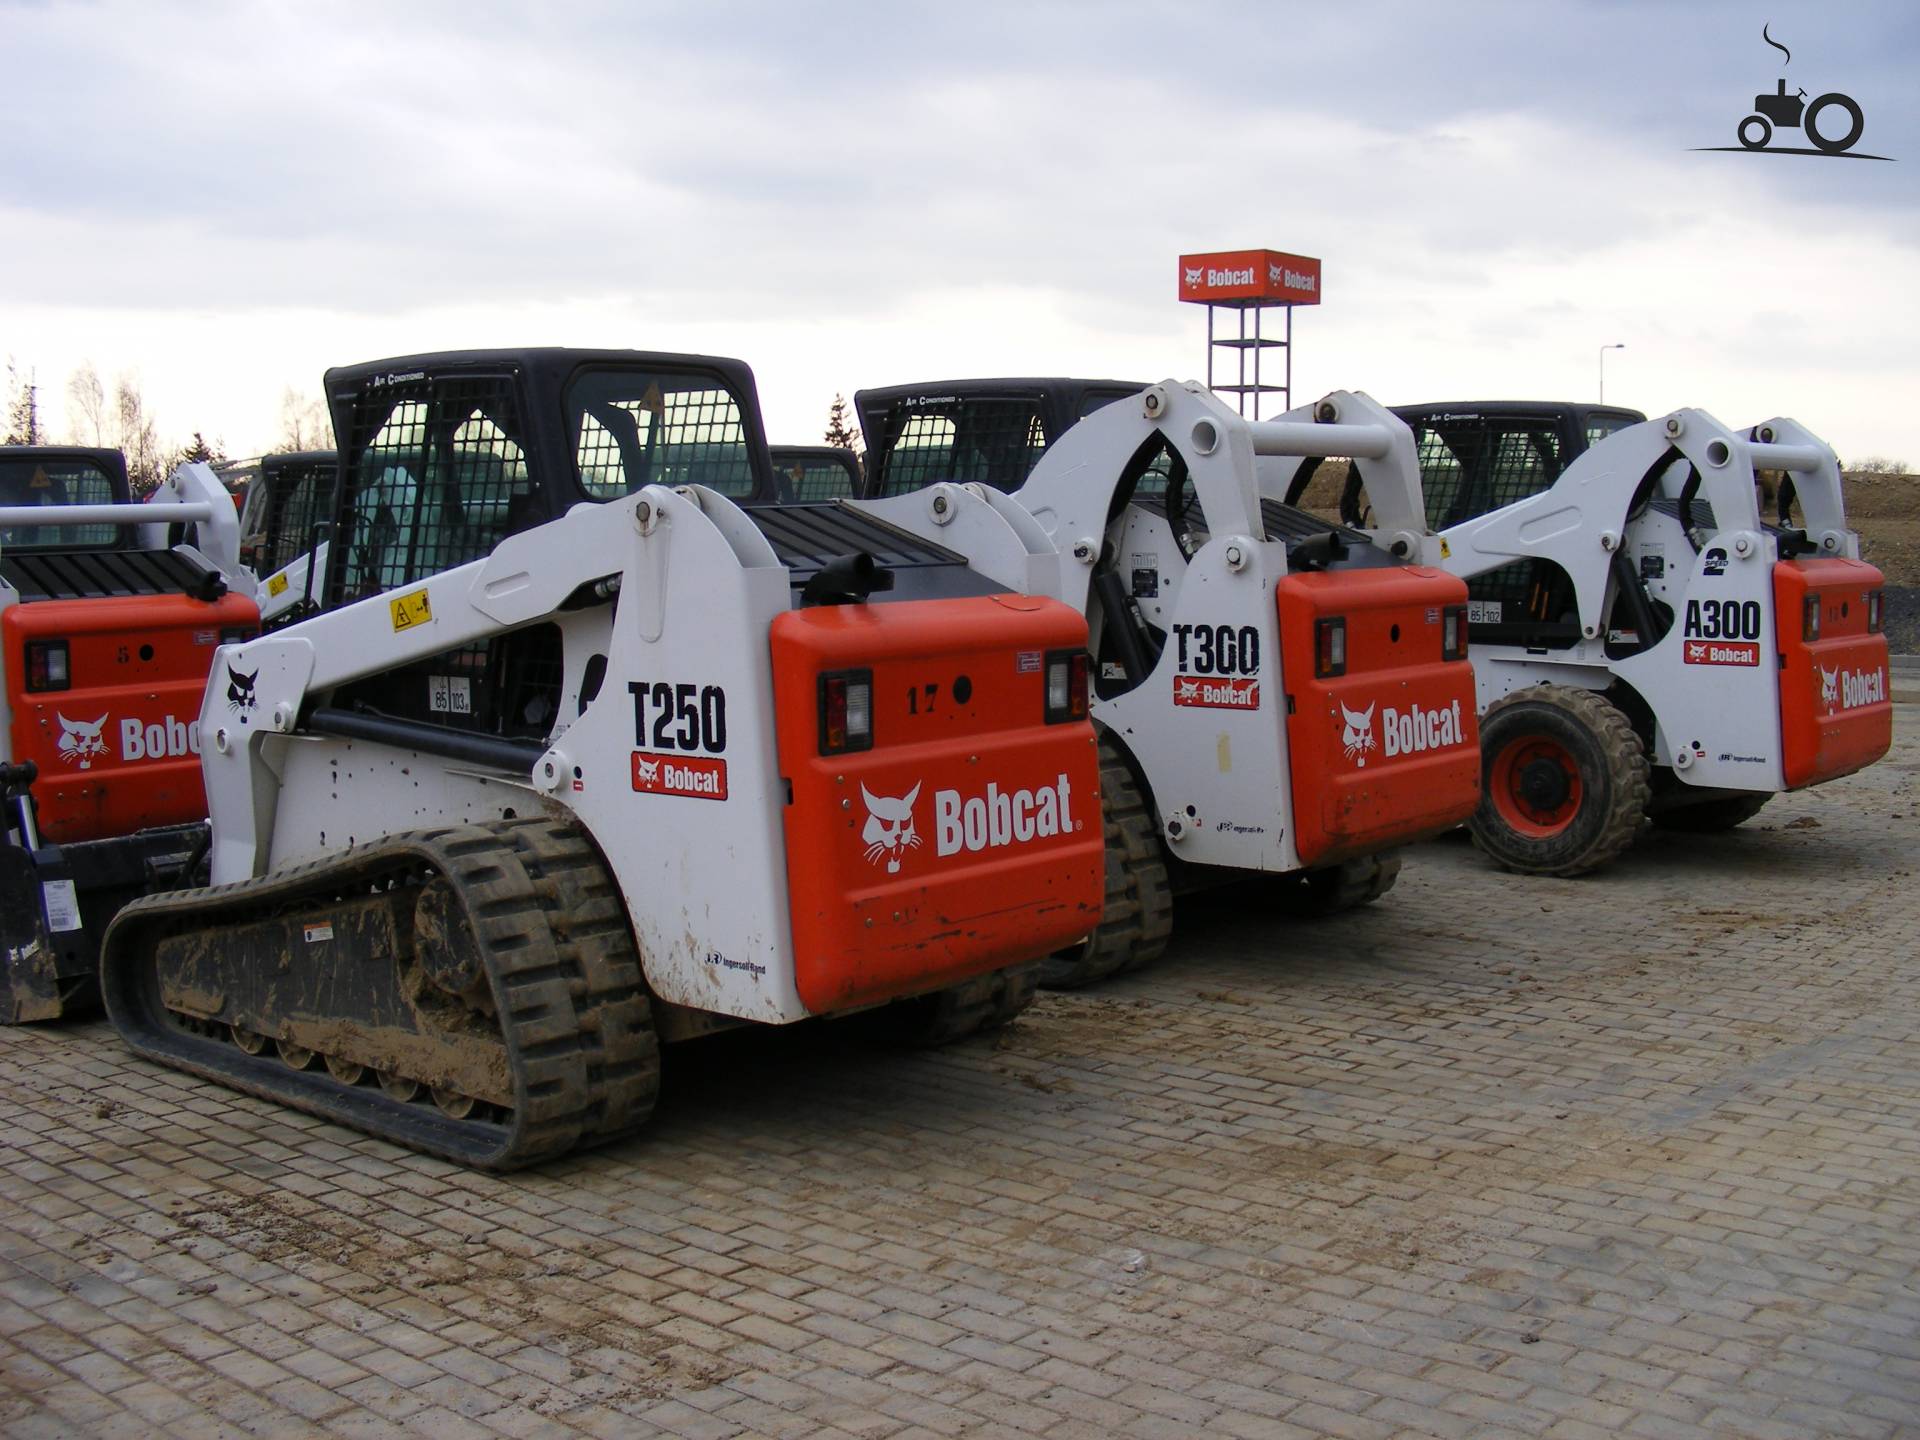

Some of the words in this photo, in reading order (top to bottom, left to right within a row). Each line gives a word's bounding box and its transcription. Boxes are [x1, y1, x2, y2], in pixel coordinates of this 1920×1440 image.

[1207, 267, 1255, 287] Bobcat
[1284, 270, 1316, 292] Bobcat
[1684, 600, 1761, 640] A300
[1710, 648, 1753, 663] Bobcat
[435, 691, 448, 709] 85
[906, 683, 939, 715] 17
[1203, 684, 1252, 705] Bobcat
[1842, 666, 1884, 709] Bobcat
[628, 681, 727, 753] T250
[1382, 699, 1463, 757] Bobcat
[664, 764, 720, 793] Bobcat
[935, 773, 1073, 857] Bobcat
